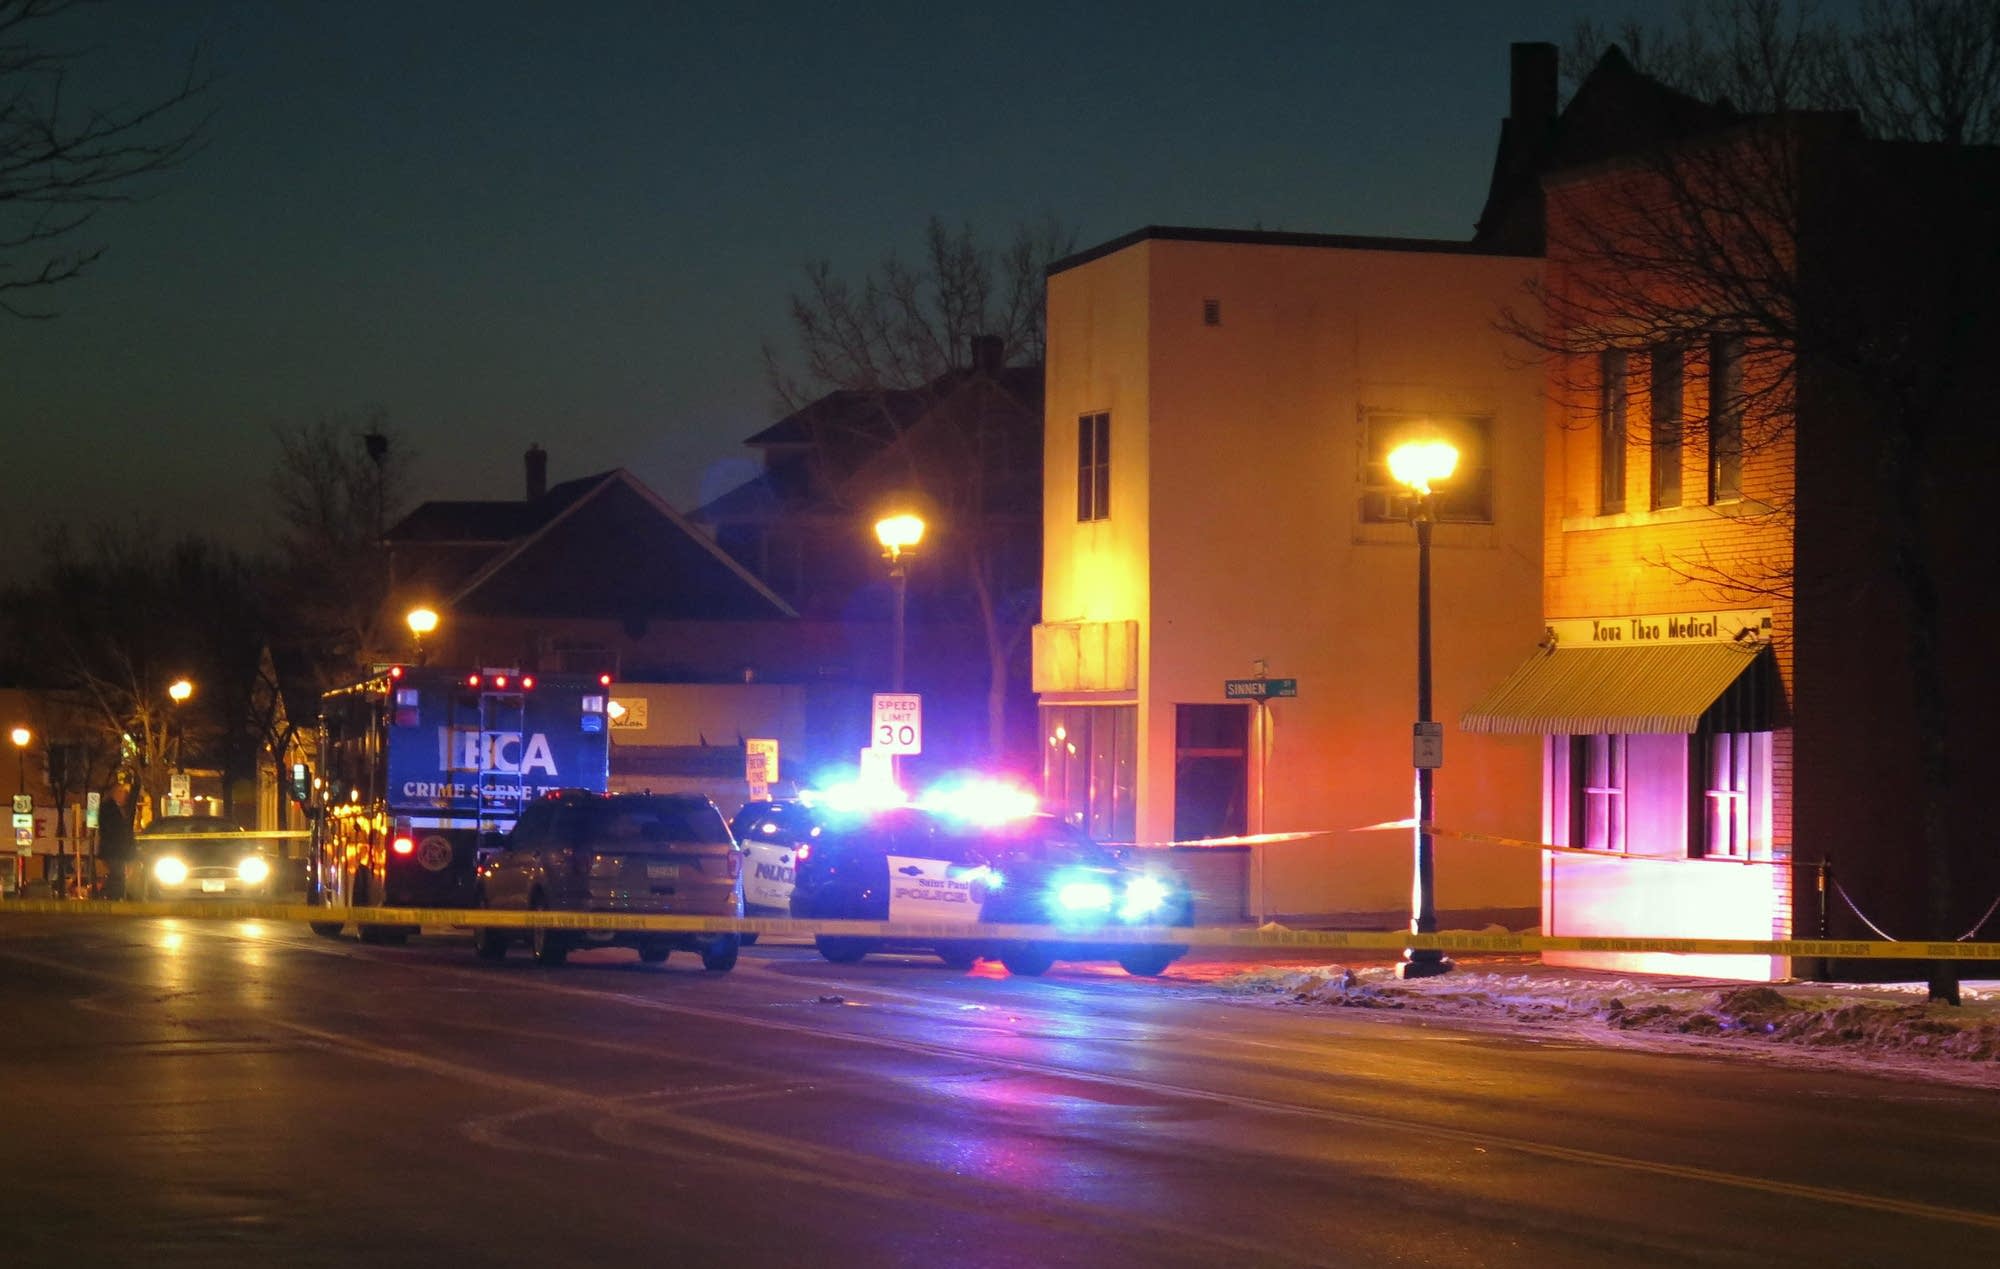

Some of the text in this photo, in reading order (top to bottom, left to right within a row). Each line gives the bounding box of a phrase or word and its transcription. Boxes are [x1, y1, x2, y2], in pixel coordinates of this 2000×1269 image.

[1593, 616, 1717, 641] Xoua Thao Medical
[1227, 683, 1266, 695] SINNEN
[878, 701, 916, 710] SPEED
[881, 713, 911, 722] LIMIT
[879, 725, 915, 746] 30
[465, 731, 558, 776] BCA
[403, 782, 465, 799] CRIME
[470, 783, 532, 801] SCENE
[919, 879, 969, 890] Saint Paul
[895, 887, 968, 902] POLICE
